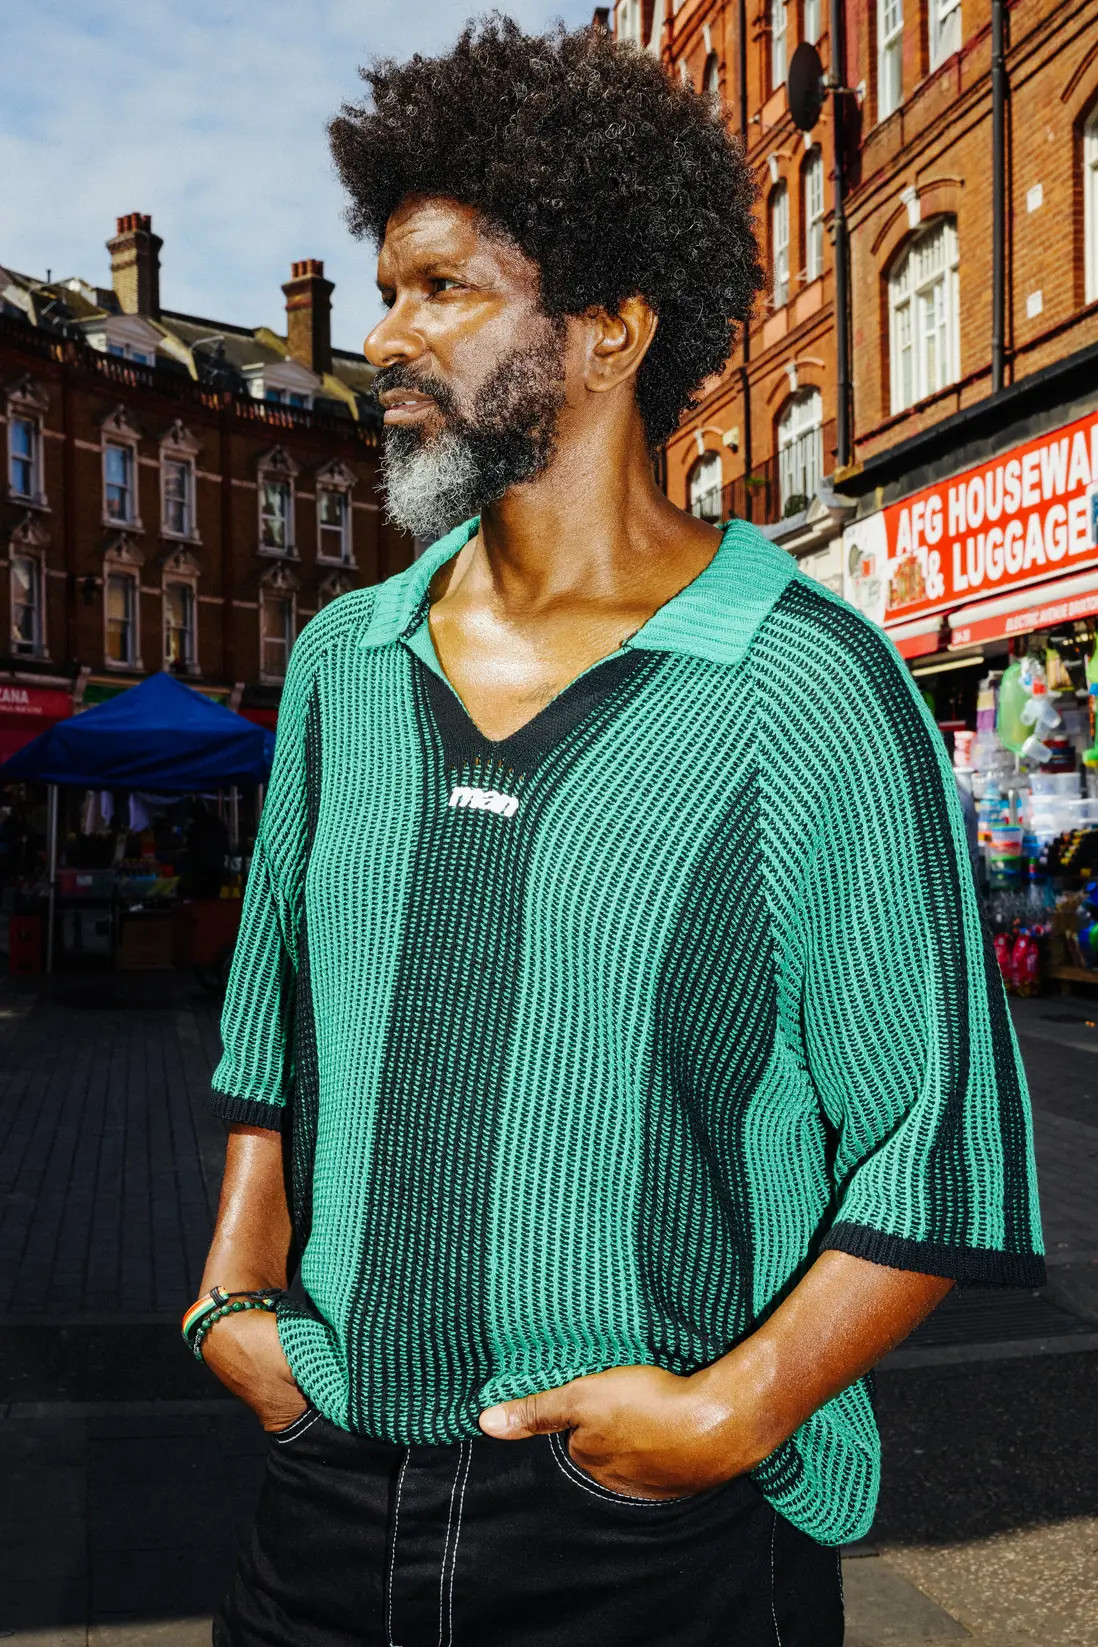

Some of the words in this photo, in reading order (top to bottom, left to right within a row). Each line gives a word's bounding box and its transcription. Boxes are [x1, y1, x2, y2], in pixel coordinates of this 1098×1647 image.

[896, 494, 943, 556] AFG
[926, 550, 945, 600] &
[448, 786, 519, 817] man
